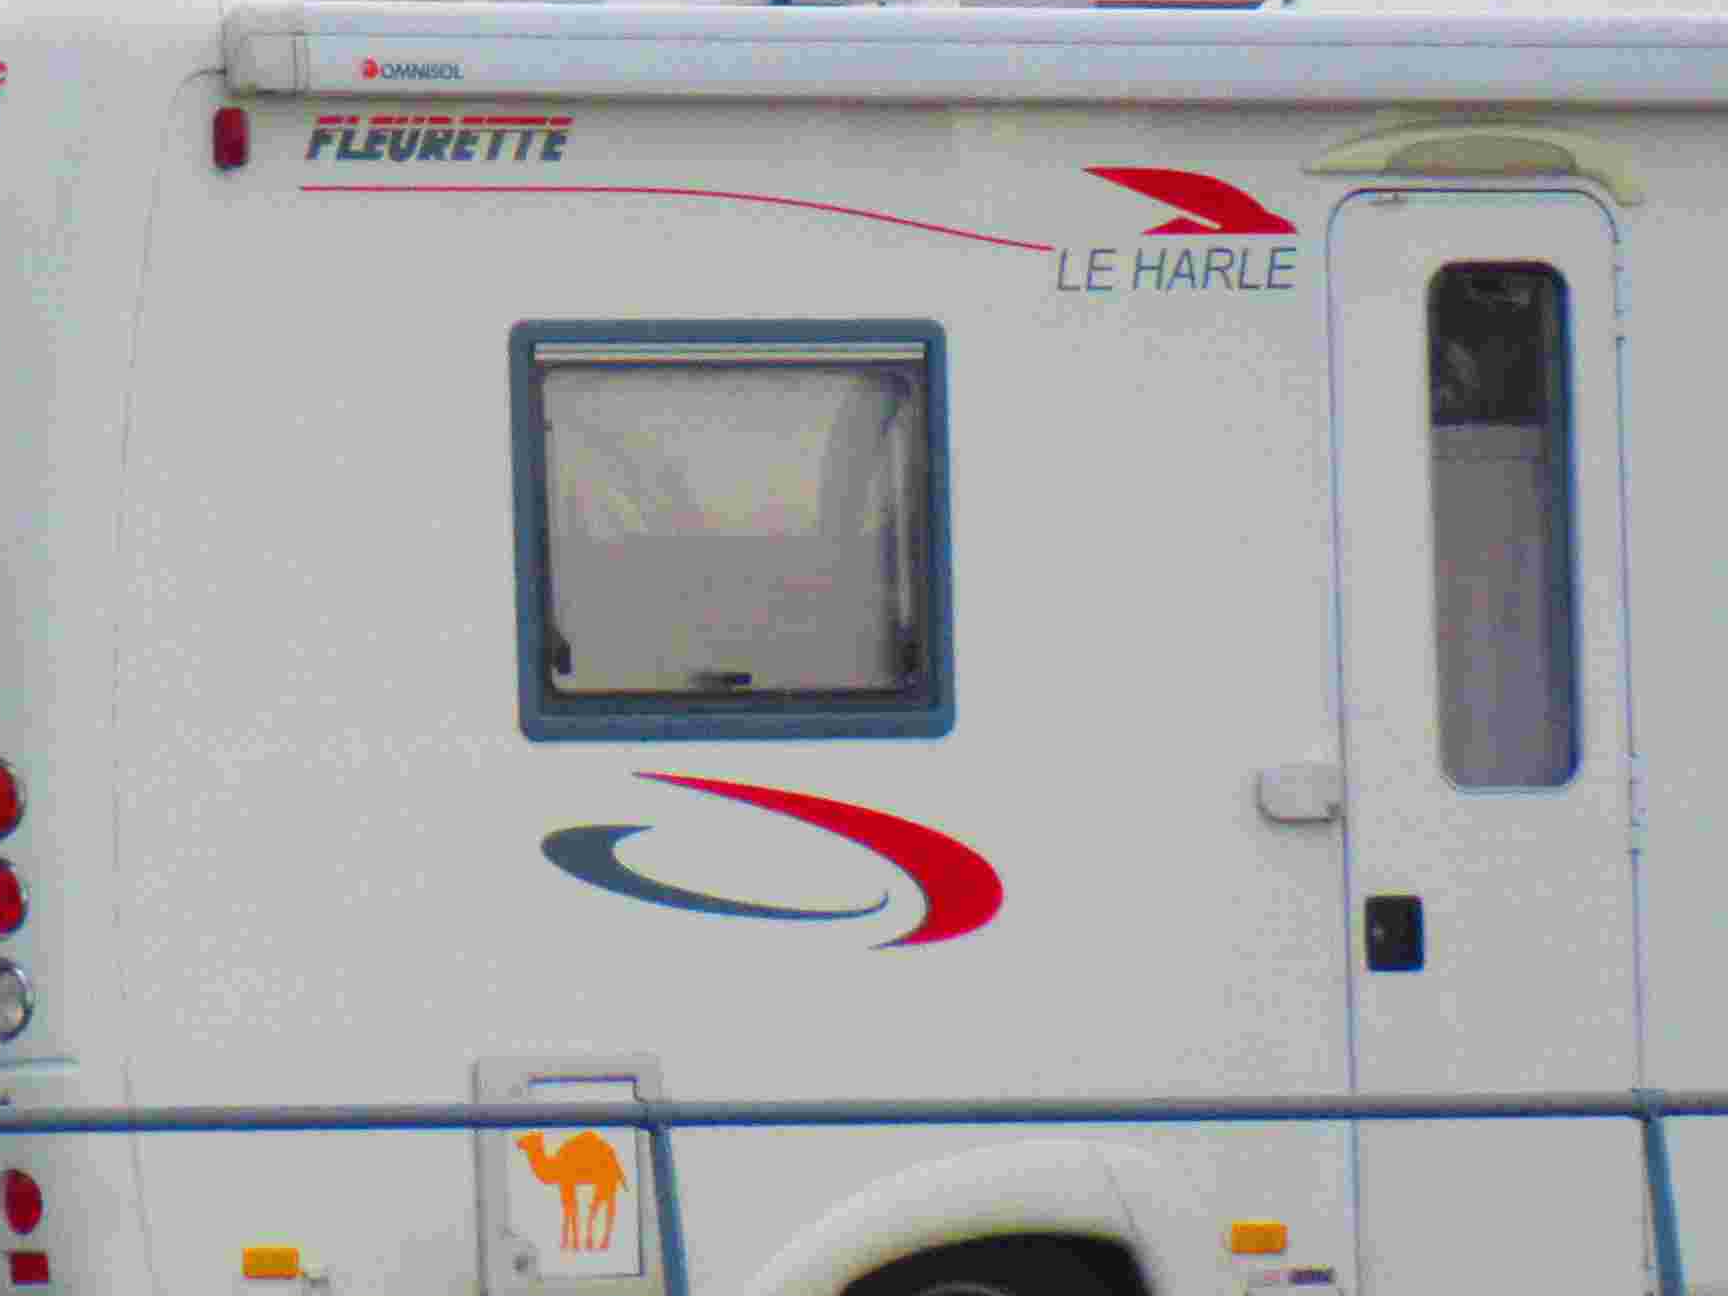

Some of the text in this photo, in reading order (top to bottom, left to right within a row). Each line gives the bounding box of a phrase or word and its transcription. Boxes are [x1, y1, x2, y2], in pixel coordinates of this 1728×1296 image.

[304, 115, 575, 163] FLEURETTE
[1056, 247, 1298, 293] LE HARLE
